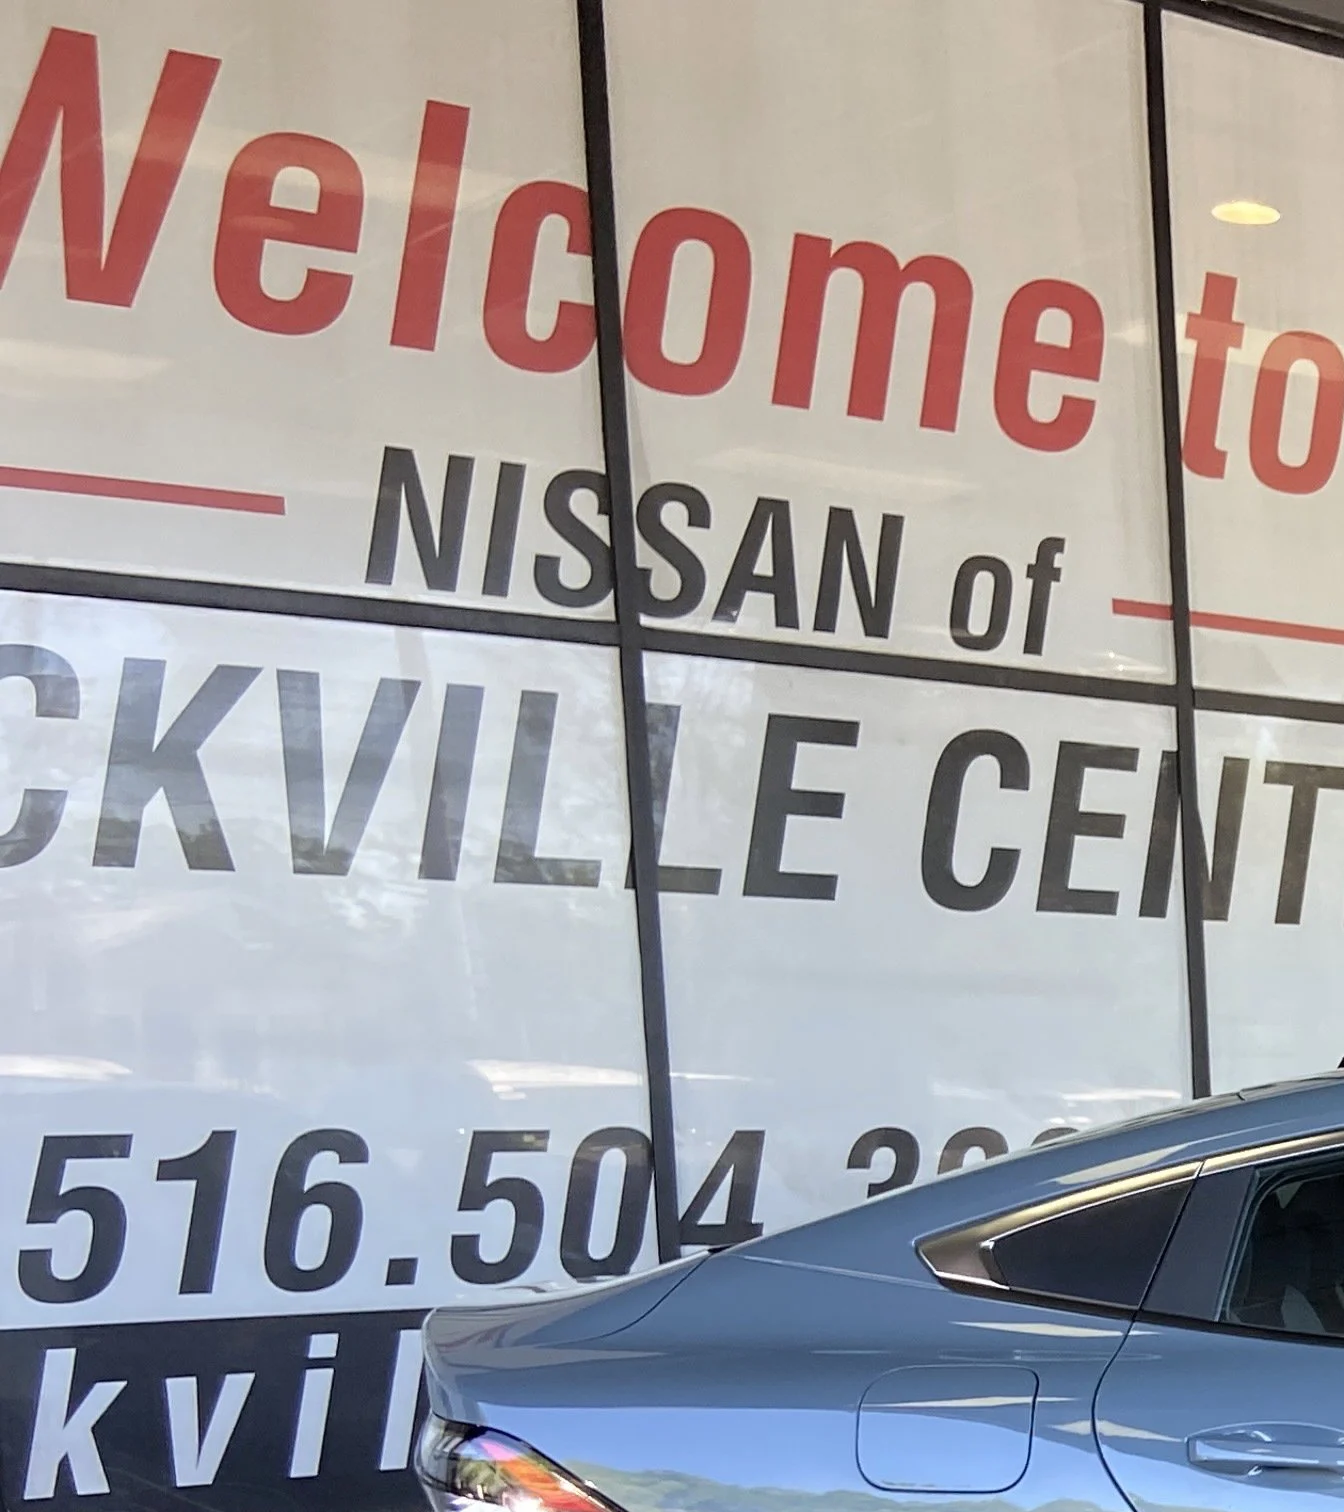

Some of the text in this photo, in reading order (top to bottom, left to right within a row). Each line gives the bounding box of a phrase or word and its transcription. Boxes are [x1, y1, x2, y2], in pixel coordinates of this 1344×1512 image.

[0, 26, 1105, 453] Welcome
[364, 446, 1066, 656] NISSAN of
